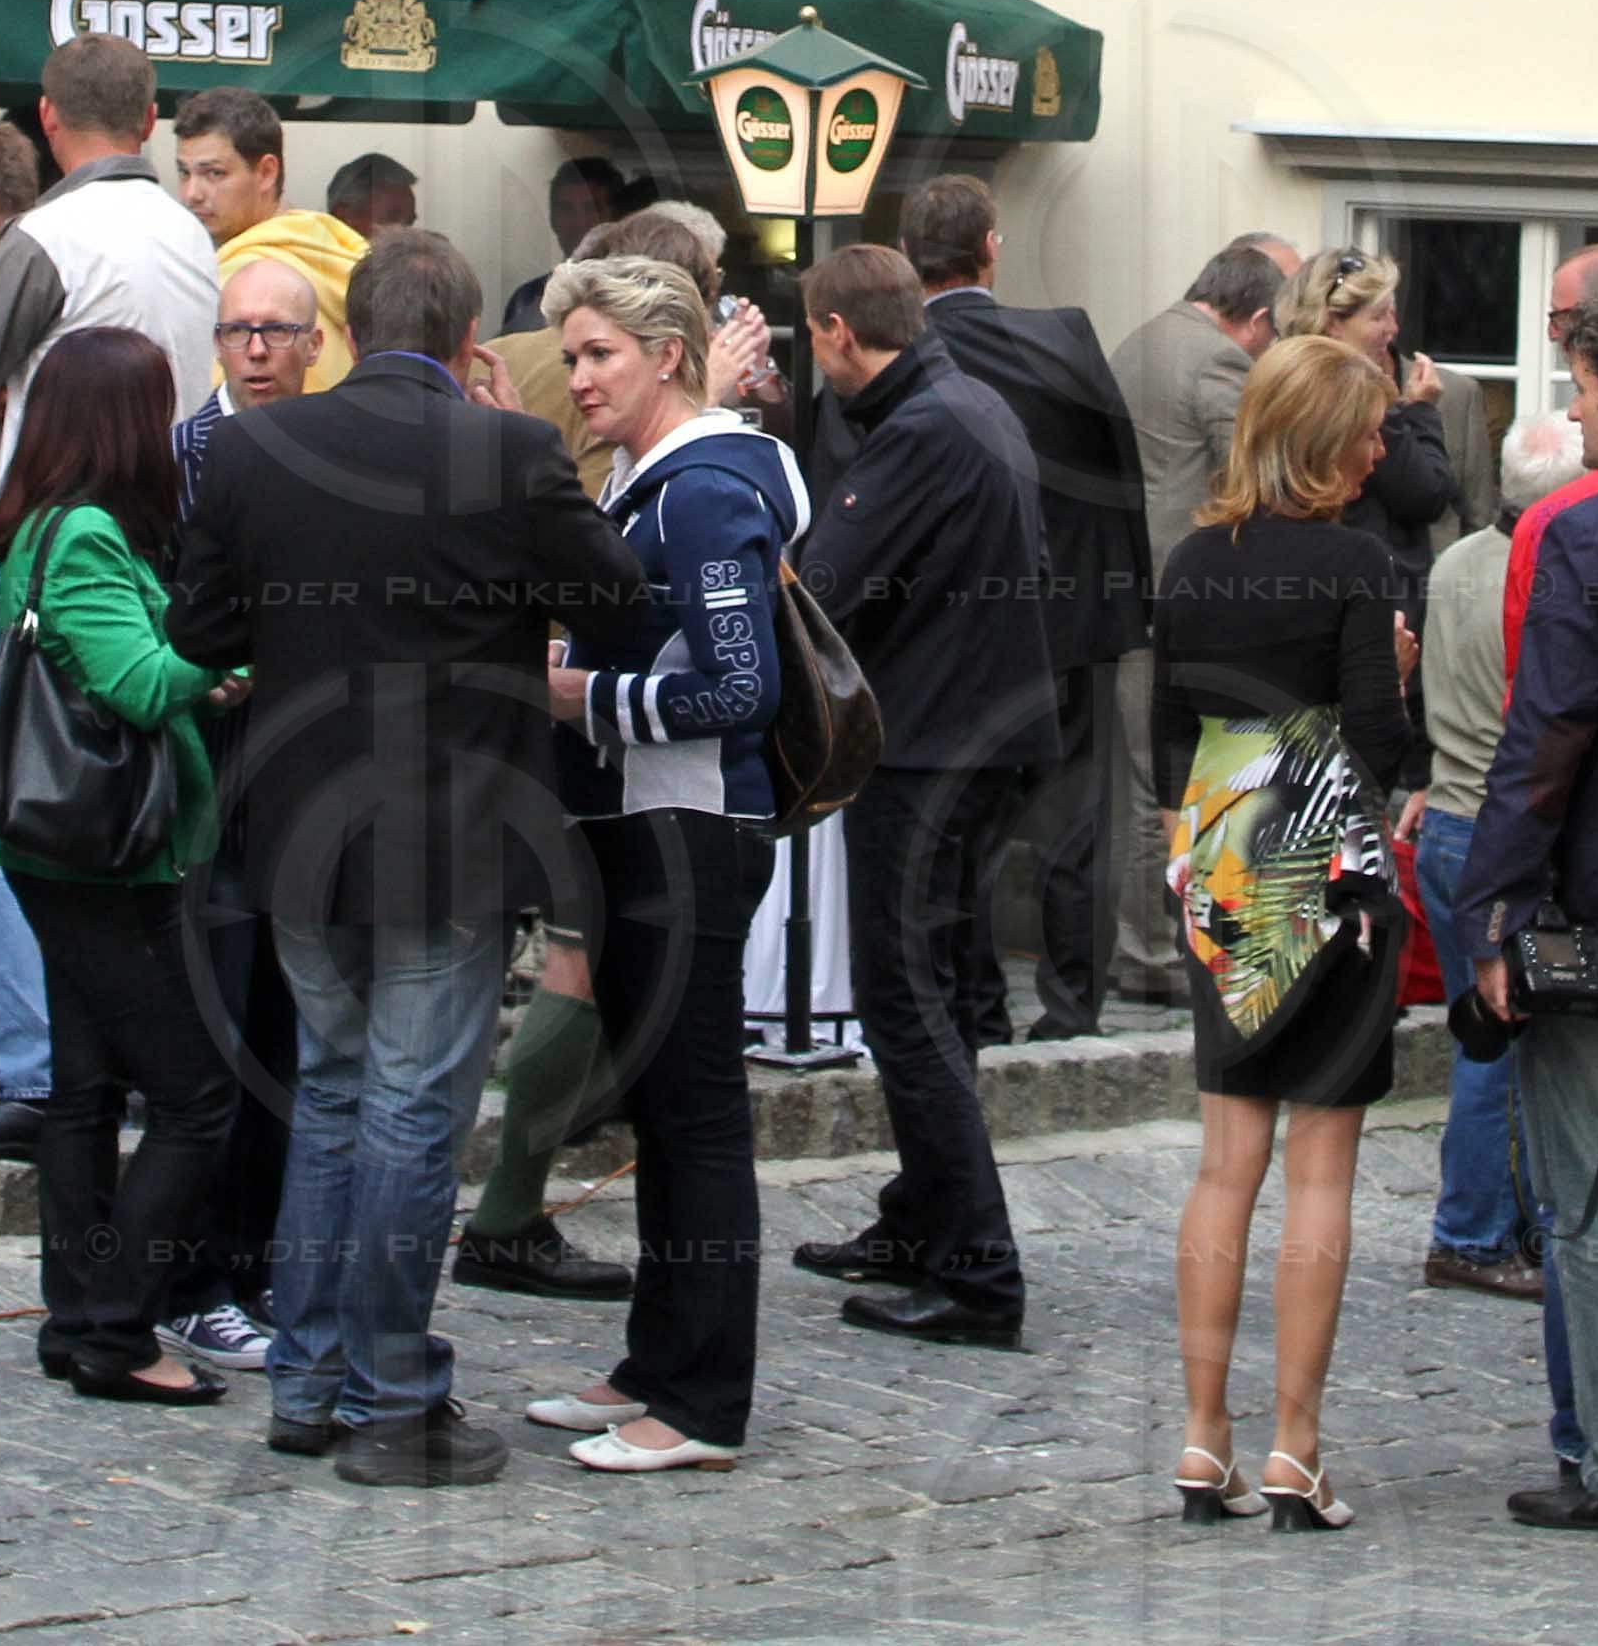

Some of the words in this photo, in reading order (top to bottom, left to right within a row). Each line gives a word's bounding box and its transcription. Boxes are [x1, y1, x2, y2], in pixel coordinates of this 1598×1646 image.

[946, 21, 1020, 127] Gösser
[736, 110, 792, 143] Gösser
[830, 114, 876, 146] Gösser
[701, 560, 742, 590] SP
